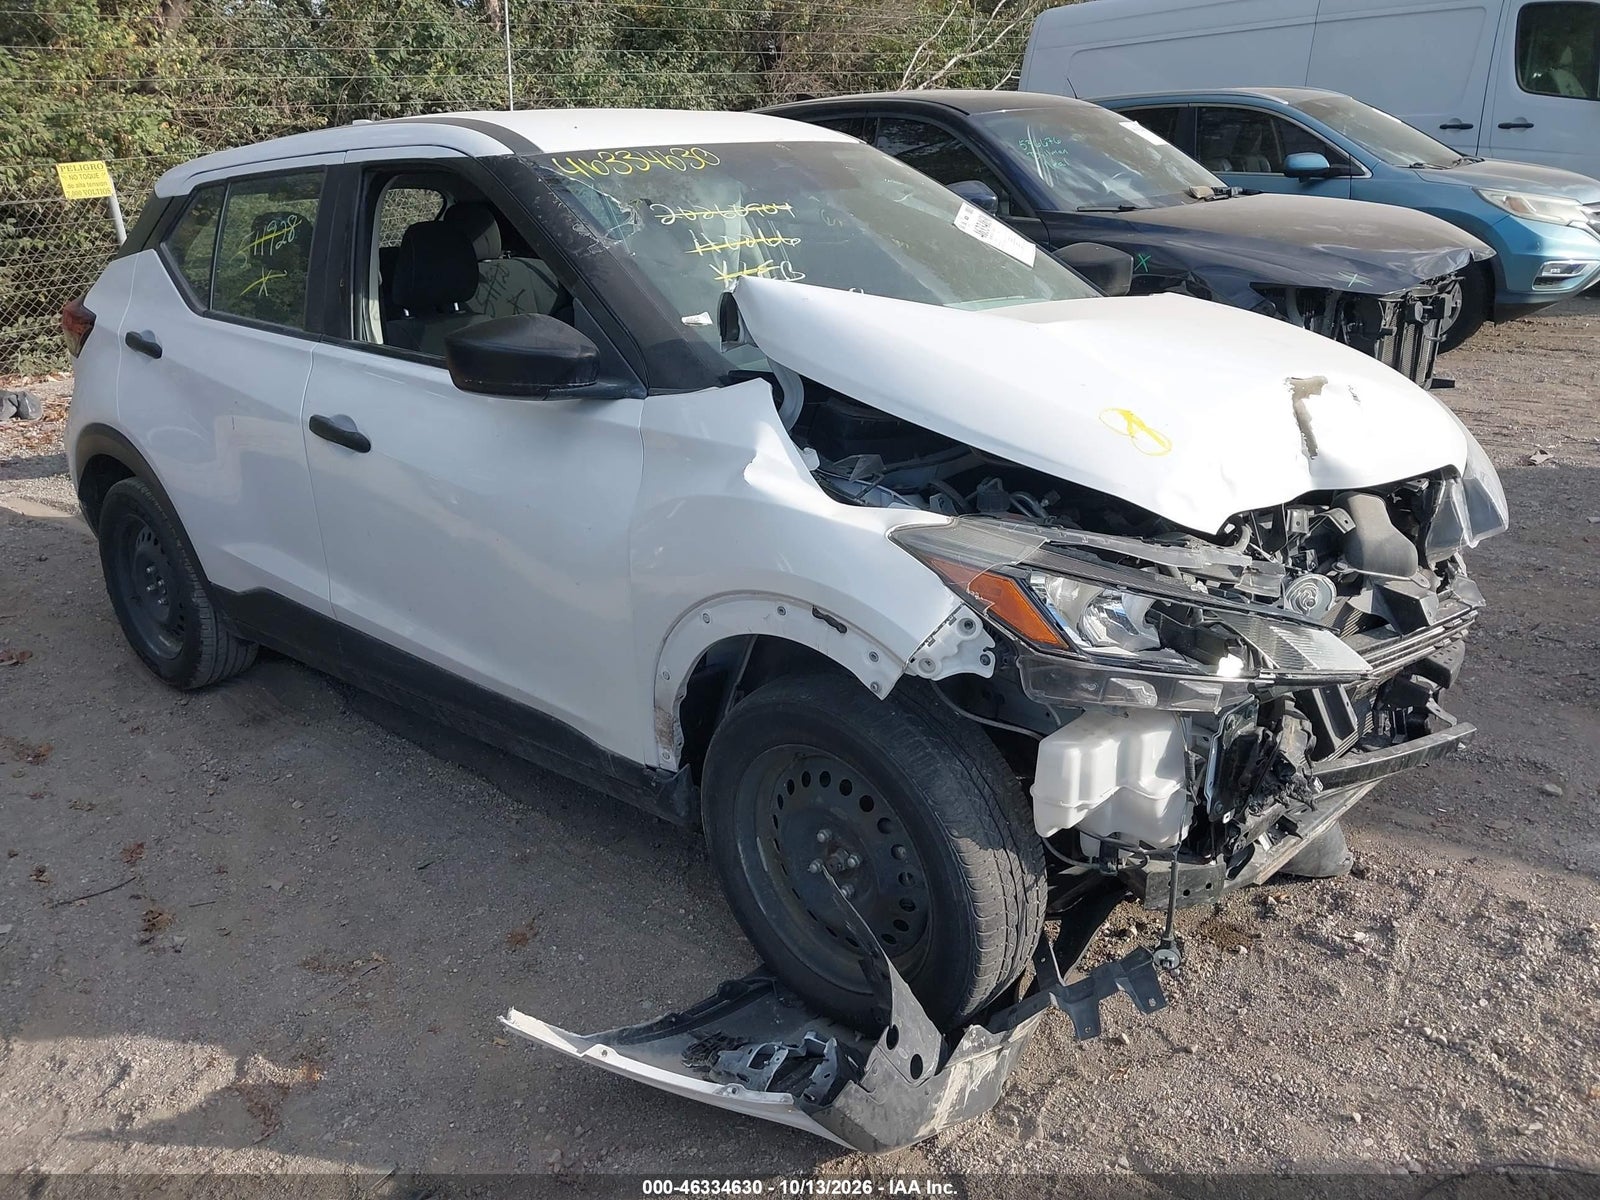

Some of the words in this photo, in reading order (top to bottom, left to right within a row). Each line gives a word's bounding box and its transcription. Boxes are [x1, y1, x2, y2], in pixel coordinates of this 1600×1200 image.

[60, 163, 104, 172] PELIGRO
[551, 147, 721, 180] 46334630
[83, 188, 112, 196] VOLTIOS
